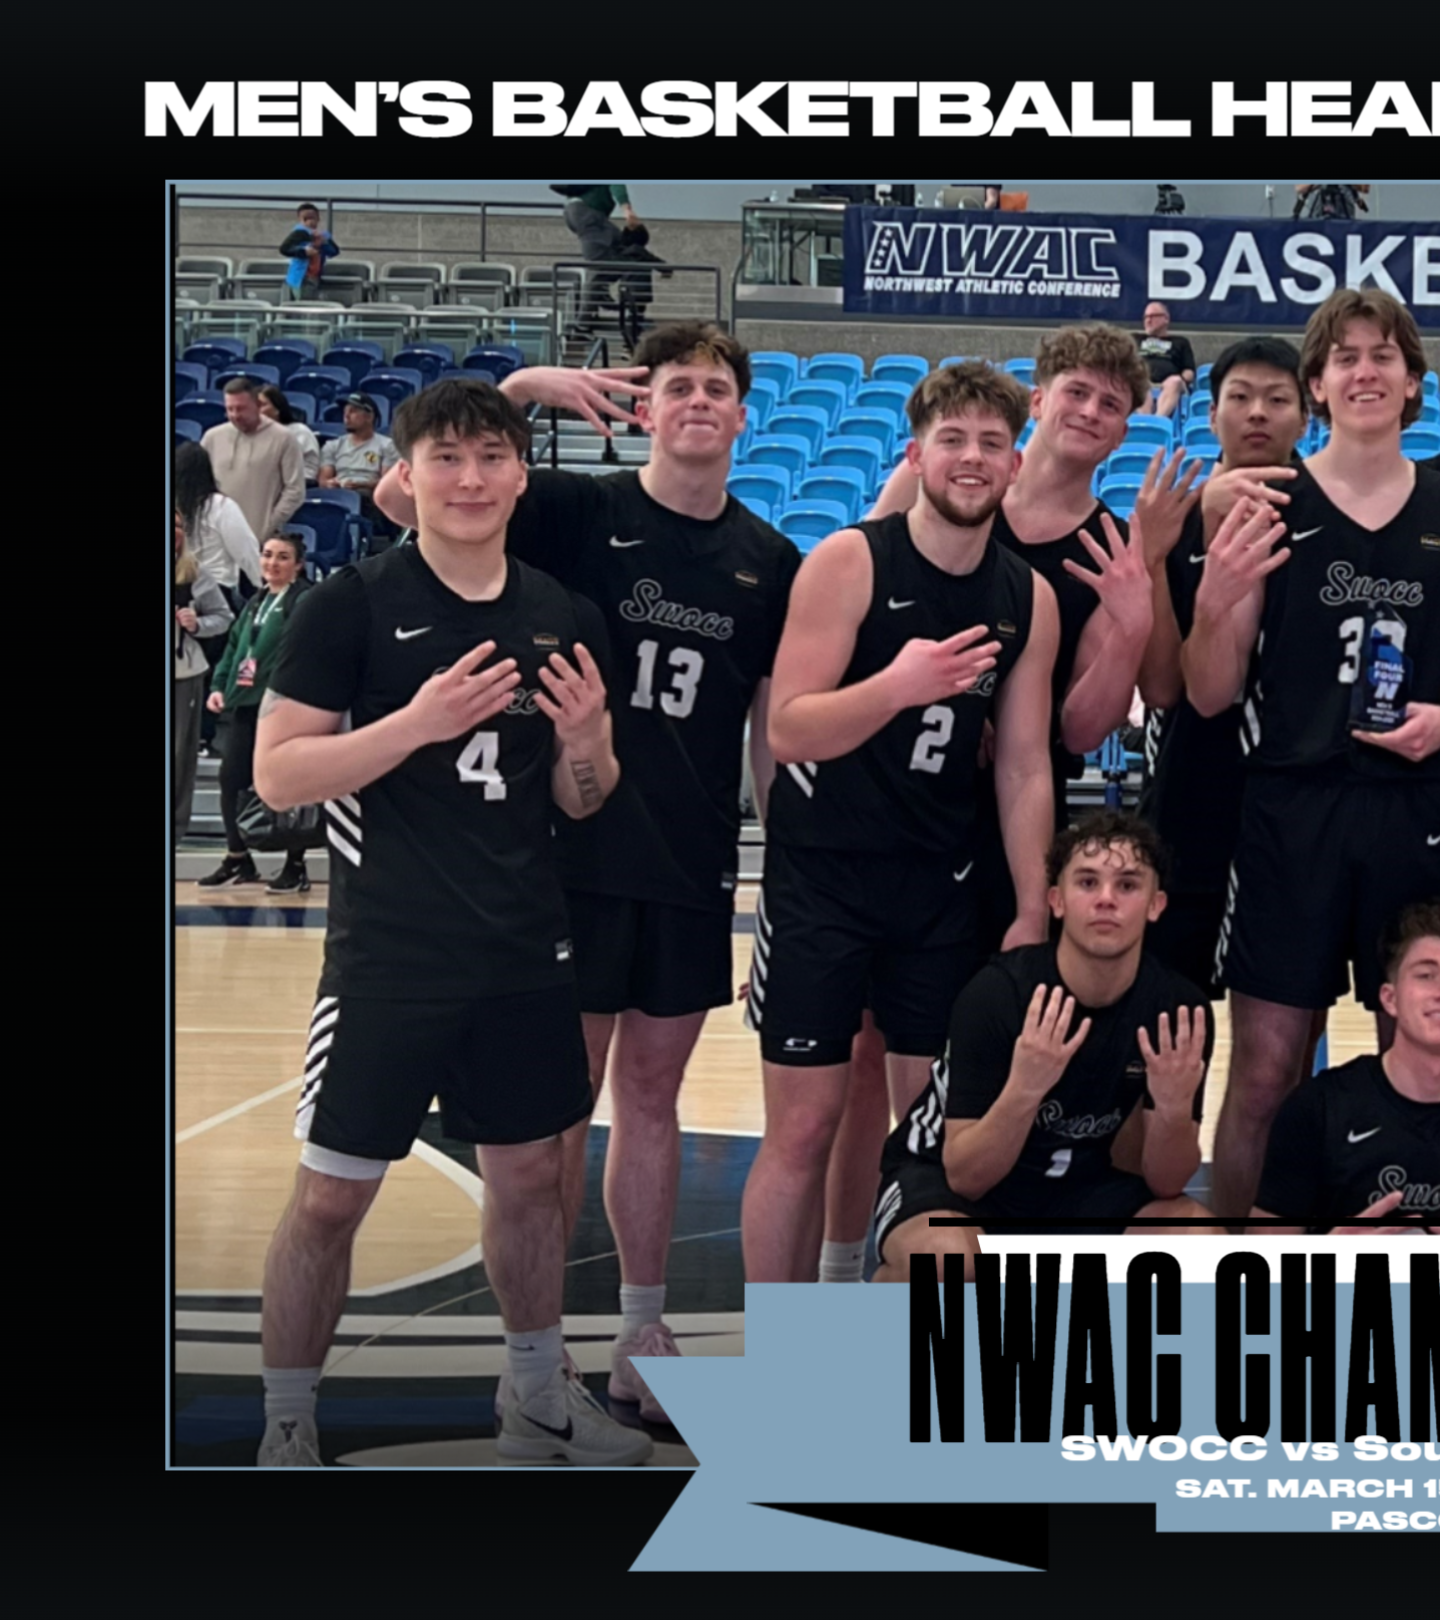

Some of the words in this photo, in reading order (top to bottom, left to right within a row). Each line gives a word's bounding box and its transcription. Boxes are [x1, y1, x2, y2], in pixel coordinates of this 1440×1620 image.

[864, 221, 1120, 279] NWAC
[863, 275, 953, 294] NORTHWEST
[954, 277, 1024, 296] ATHLETIC
[1027, 279, 1121, 299] CONFERENCE
[618, 577, 735, 641] Swocc
[629, 638, 706, 720] 13
[1373, 660, 1405, 673] FINAL
[1373, 670, 1403, 682] FOUR
[455, 730, 508, 801] 4
[908, 703, 956, 775] 2
